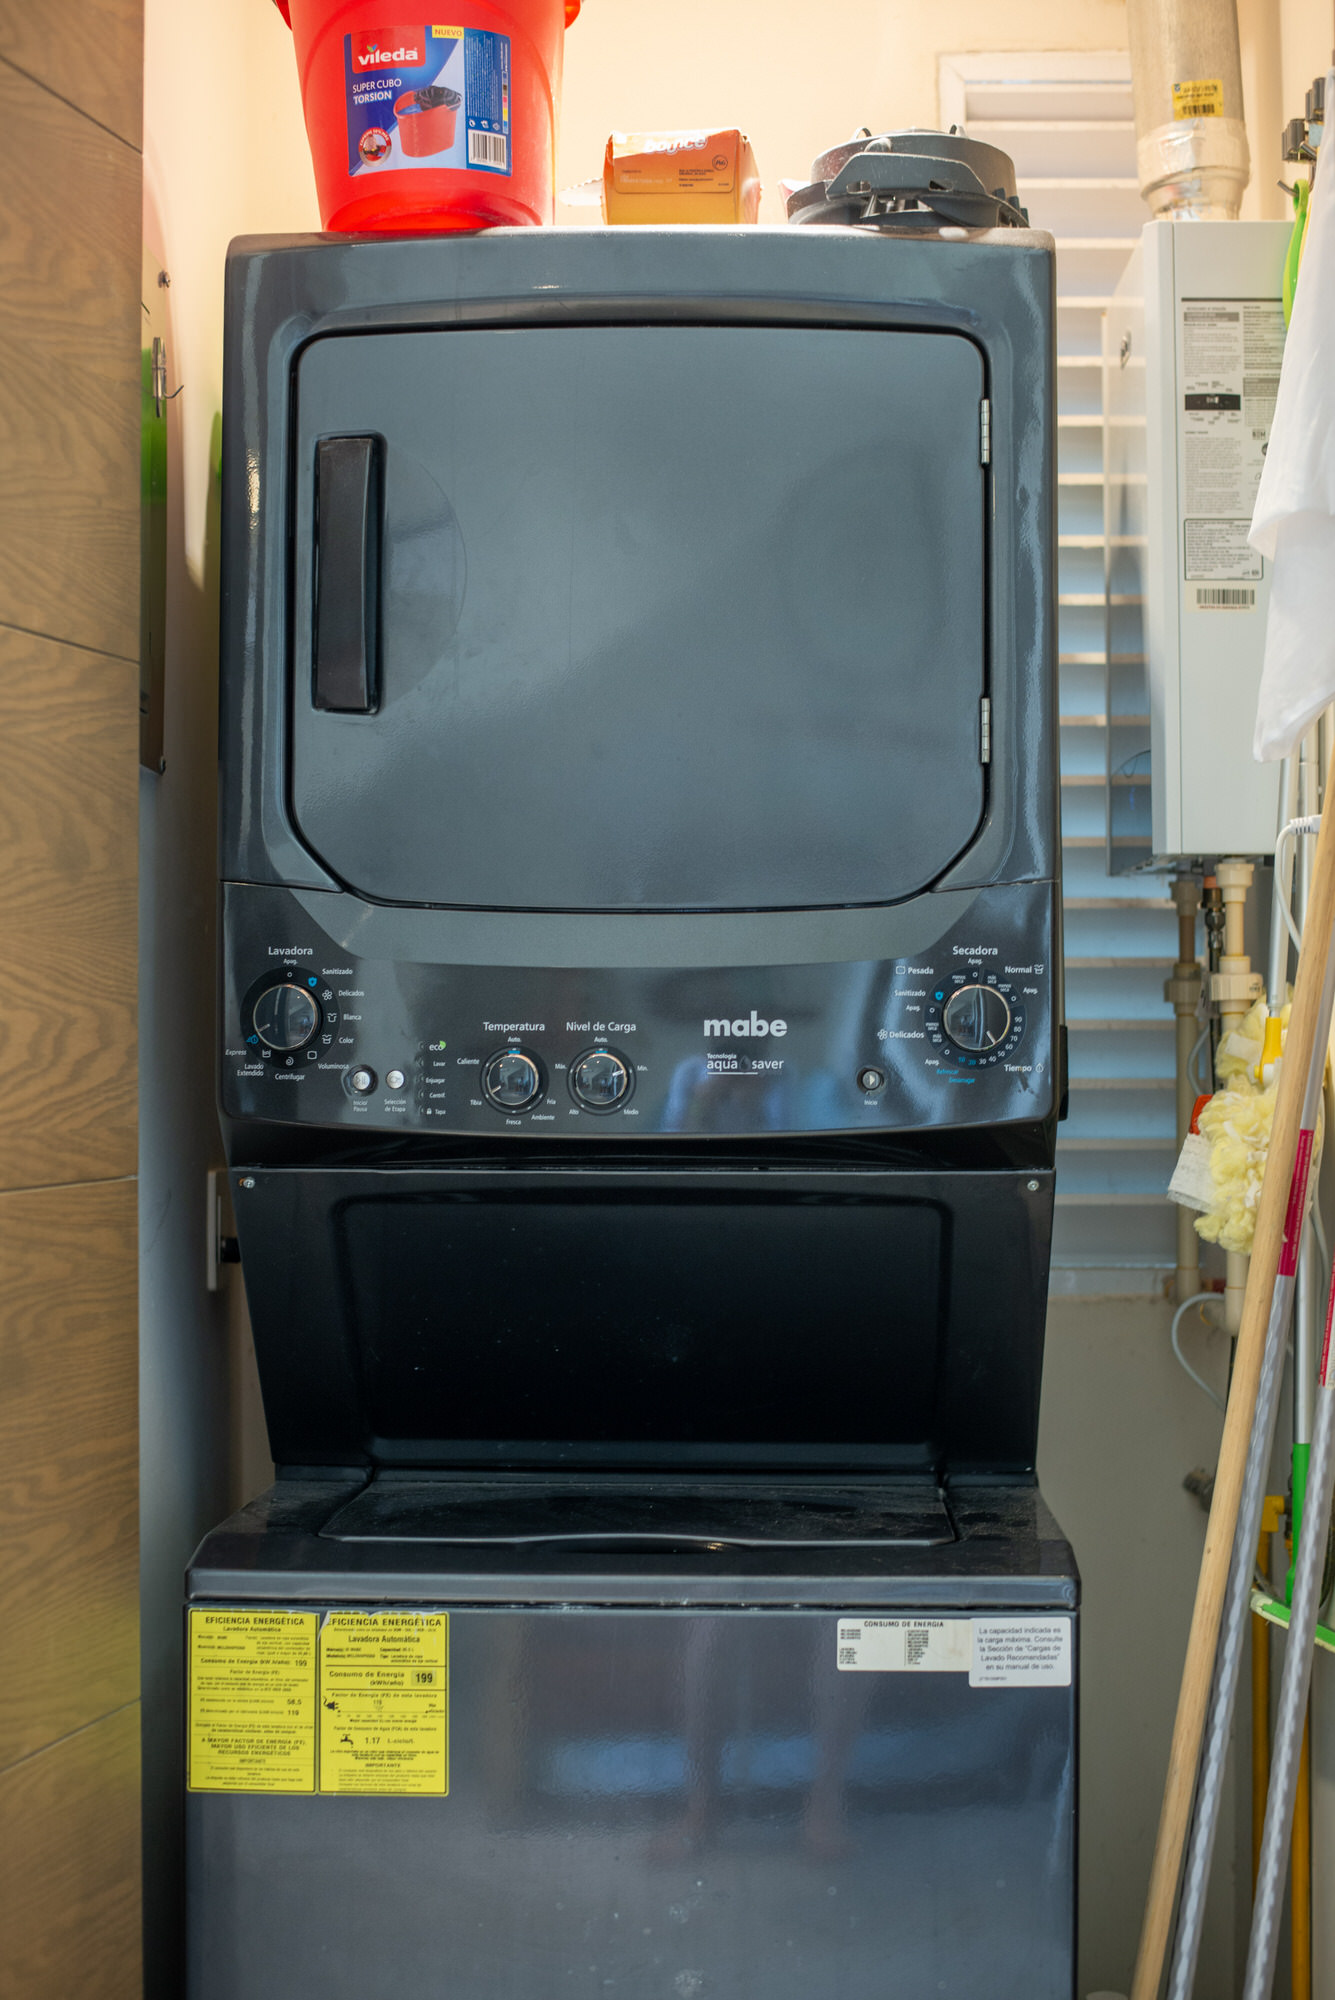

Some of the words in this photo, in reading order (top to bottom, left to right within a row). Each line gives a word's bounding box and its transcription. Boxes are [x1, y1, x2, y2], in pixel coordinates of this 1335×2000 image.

[358, 47, 418, 65] vileda
[352, 81, 376, 93] SUPER
[376, 78, 402, 88] CUBO
[352, 90, 393, 105] TORSION
[268, 946, 313, 956] Lavadora
[952, 945, 998, 955] Secadora
[283, 958, 298, 966] Apag.
[321, 968, 353, 976] Sanitizado
[907, 966, 934, 975] Pesada
[1004, 966, 1032, 974] Normal
[894, 989, 926, 997] Sanitizado
[343, 1013, 362, 1021] Blanca
[483, 1021, 545, 1032] Temperatura
[566, 1021, 590, 1031] Nivel
[593, 1021, 605, 1031] de
[607, 1022, 636, 1033] Carga
[703, 1010, 788, 1037] mabe
[889, 1031, 924, 1039] Delicados
[429, 1043, 444, 1051] eco
[706, 1060, 738, 1071] aqua
[752, 1060, 784, 1070] saver
[1004, 1064, 1032, 1073] Tiempo
[275, 1073, 305, 1081] Centrifugar
[205, 1617, 250, 1625] EFICIENCIA
[989, 1627, 1022, 1635] capacidad
[348, 1635, 379, 1643] Lavadora
[381, 1635, 420, 1643] Automática
[416, 1673, 433, 1683] 199
